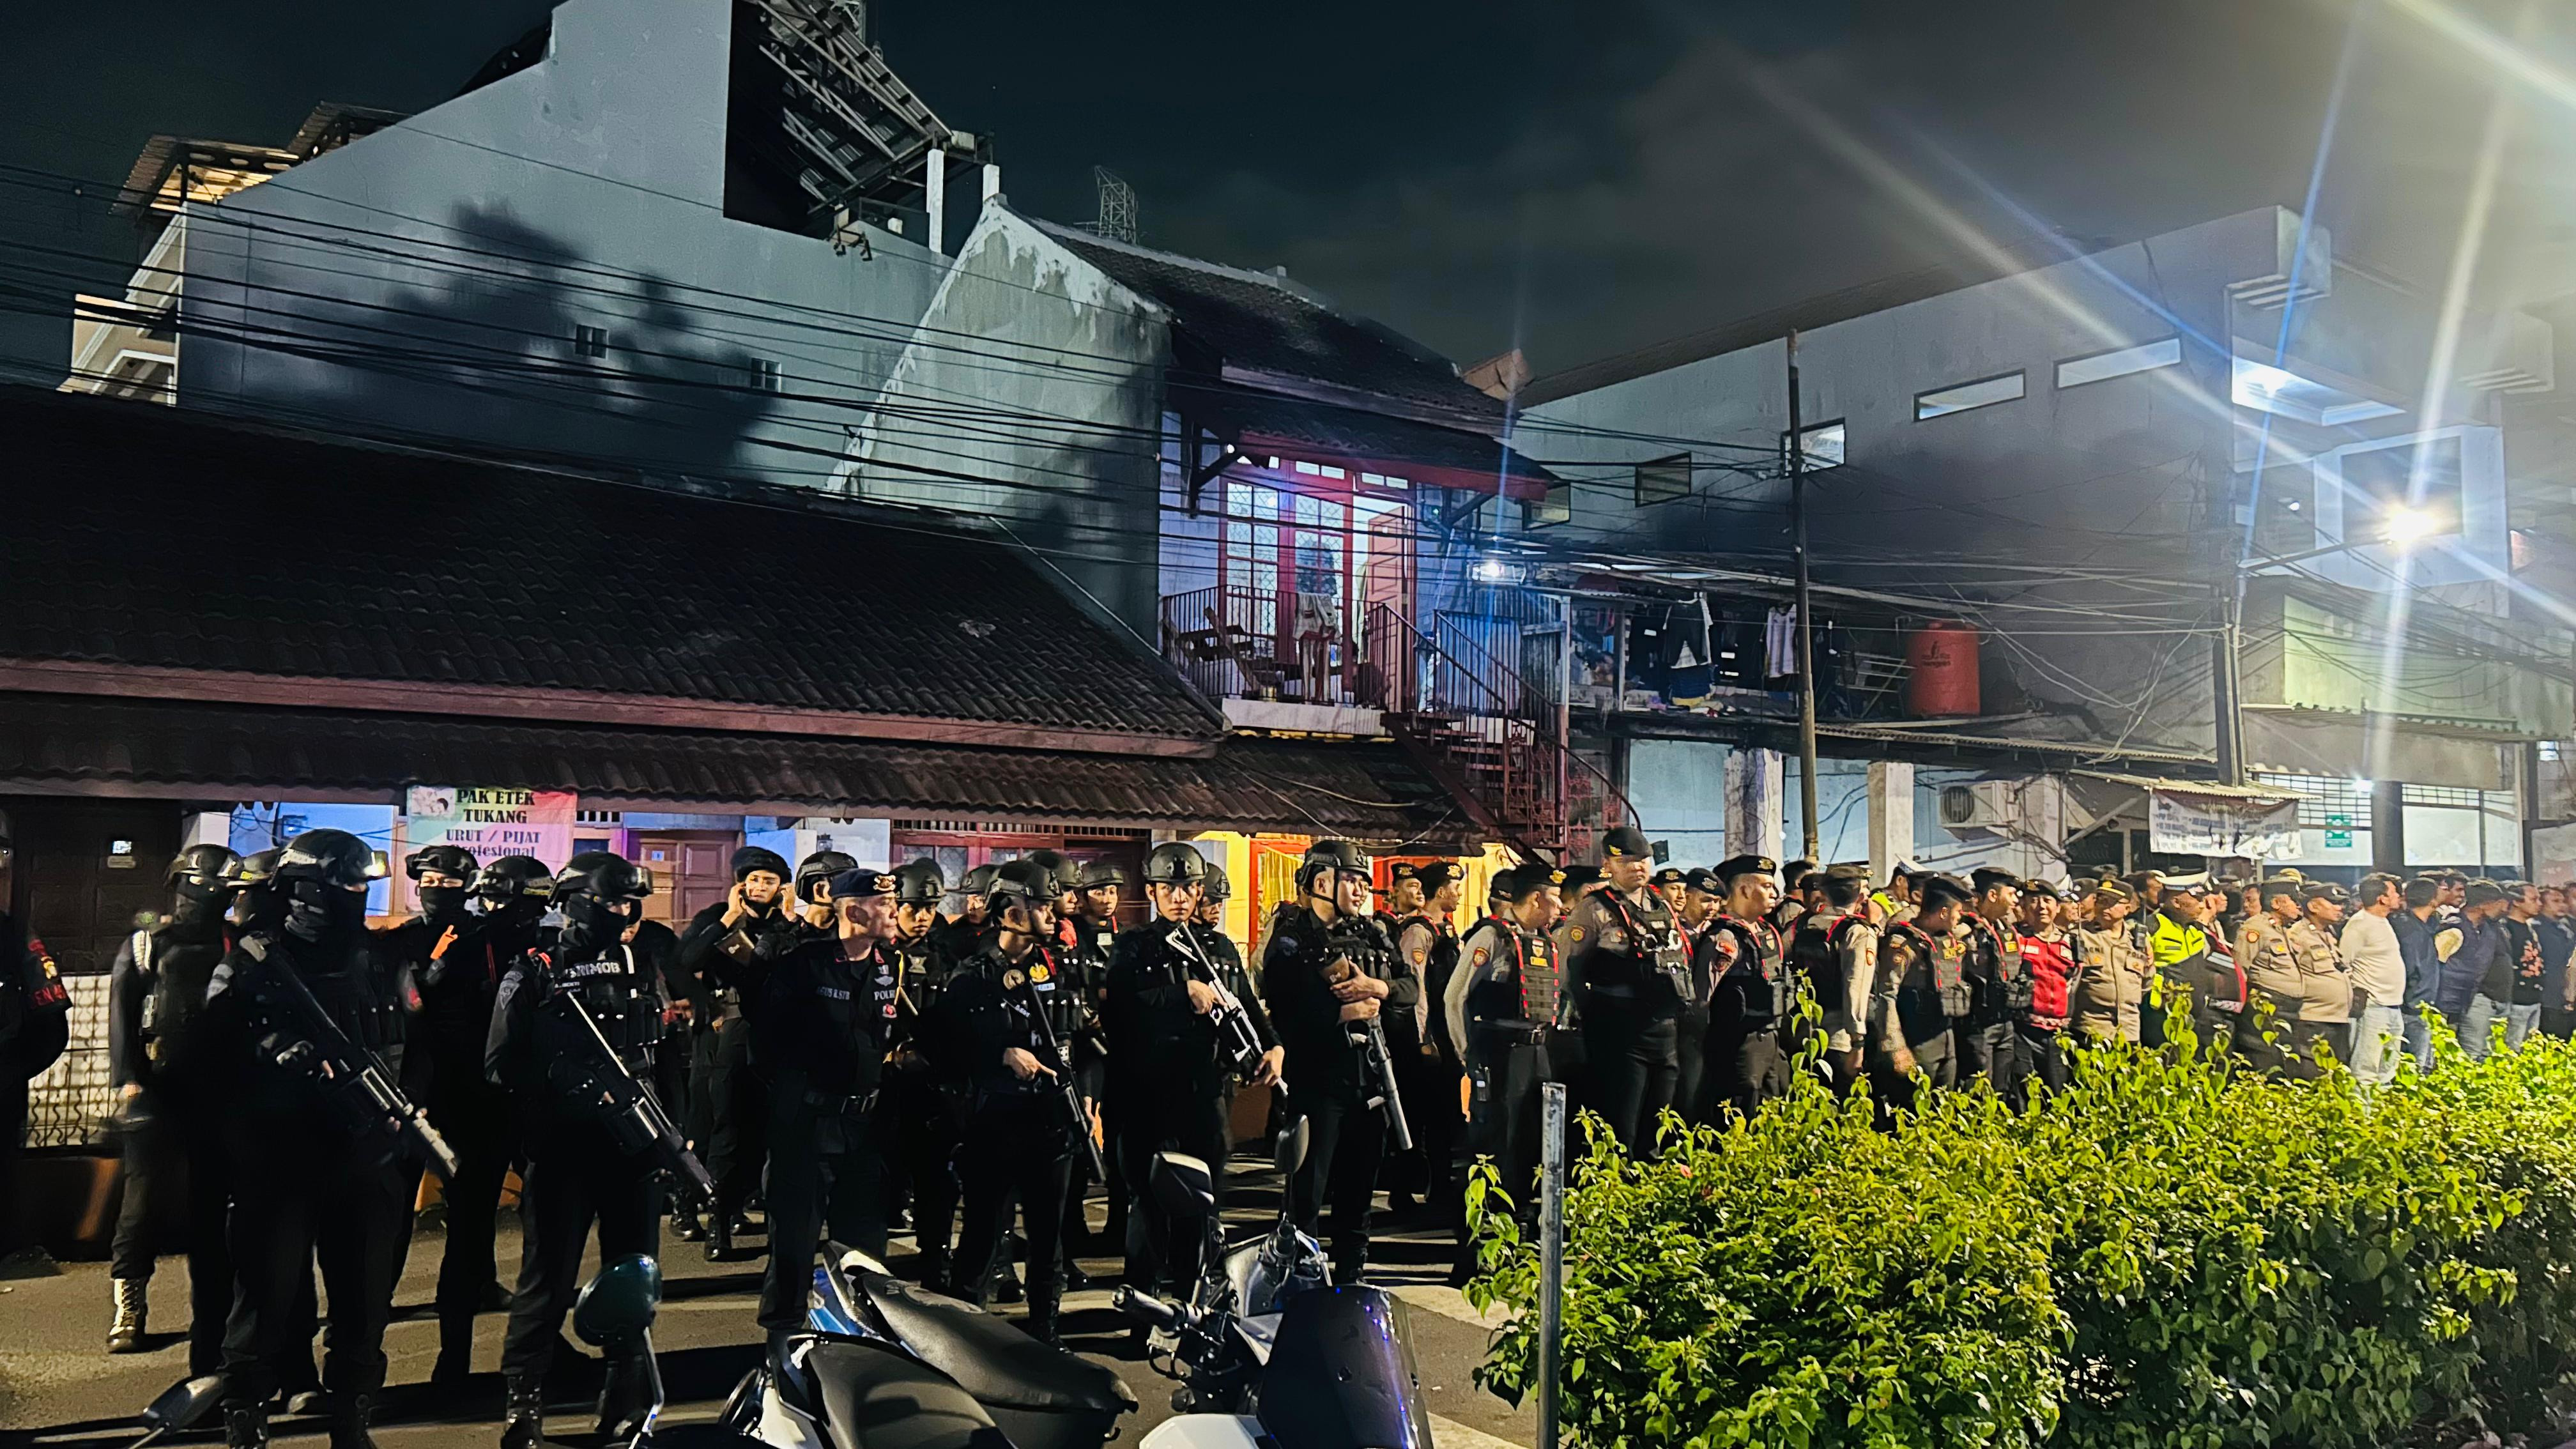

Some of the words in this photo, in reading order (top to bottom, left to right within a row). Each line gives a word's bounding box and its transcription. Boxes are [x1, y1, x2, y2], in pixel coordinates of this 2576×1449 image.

[456, 789, 491, 804] PAK
[495, 790, 535, 806] ETEK
[463, 809, 528, 824] TUKANG
[445, 829, 484, 841] URUT
[487, 830, 498, 842] /
[503, 831, 542, 845] PIJAT
